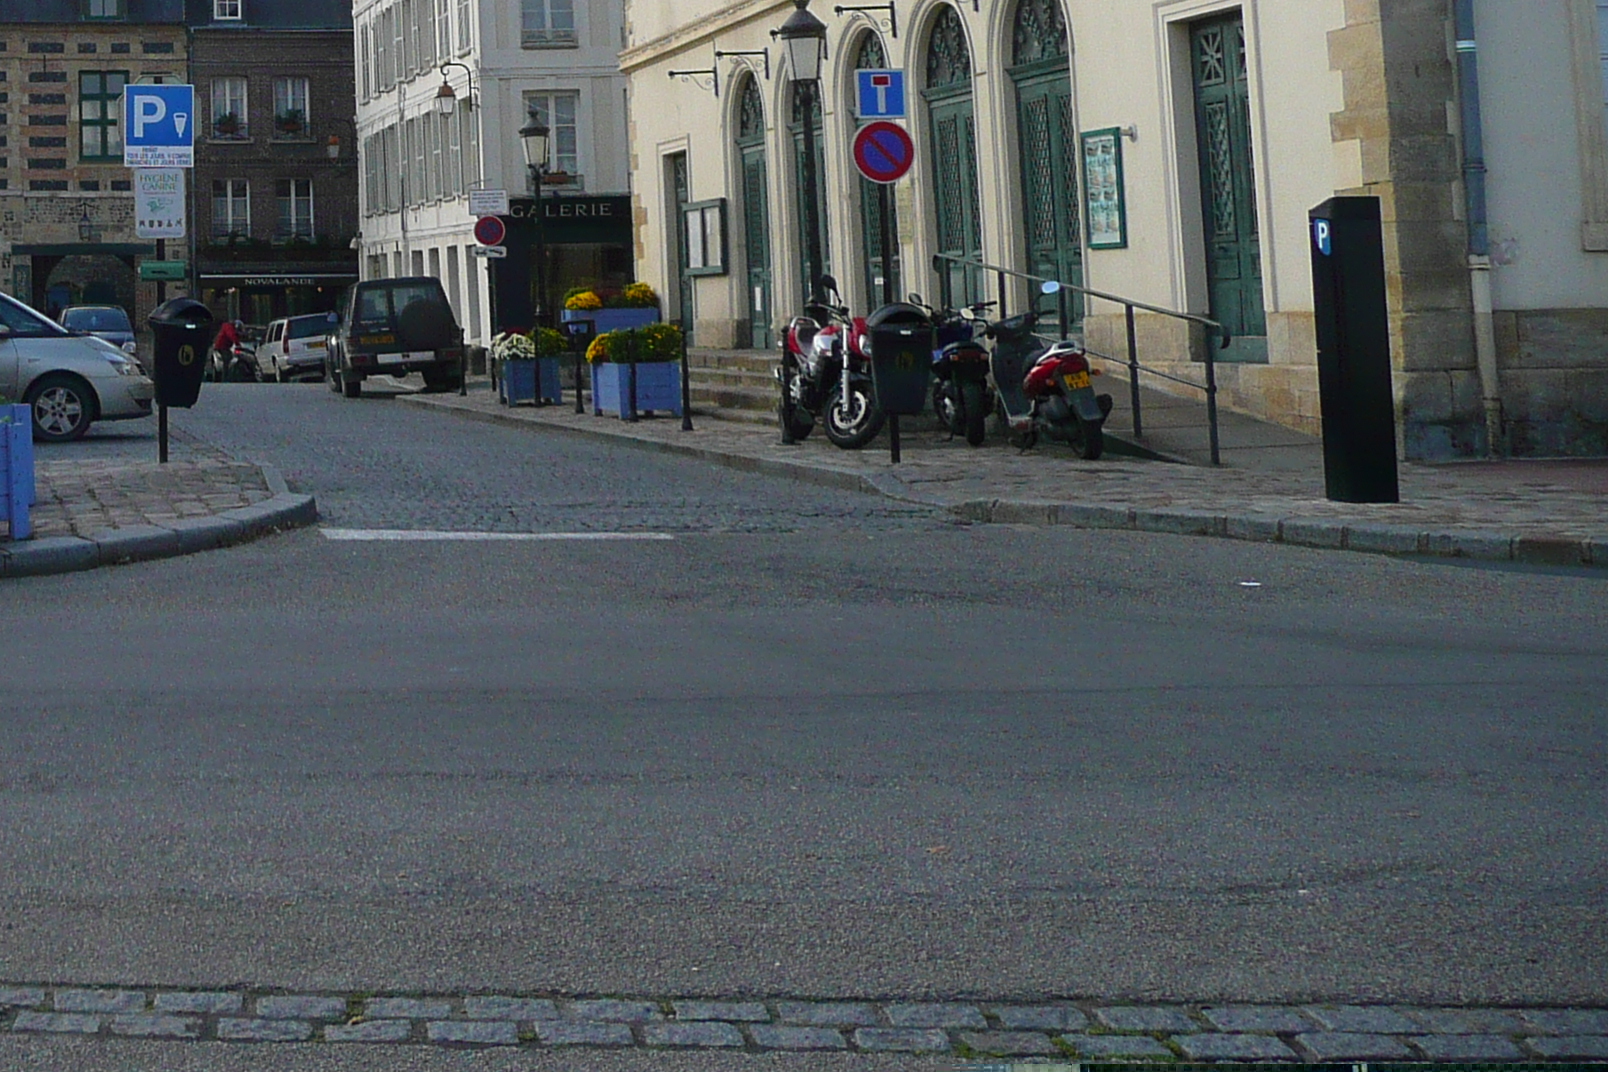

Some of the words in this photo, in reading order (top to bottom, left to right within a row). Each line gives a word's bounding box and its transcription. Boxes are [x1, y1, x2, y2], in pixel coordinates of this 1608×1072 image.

[133, 94, 167, 138] P
[1318, 221, 1328, 249] P
[244, 278, 316, 286] NOVALANDE
